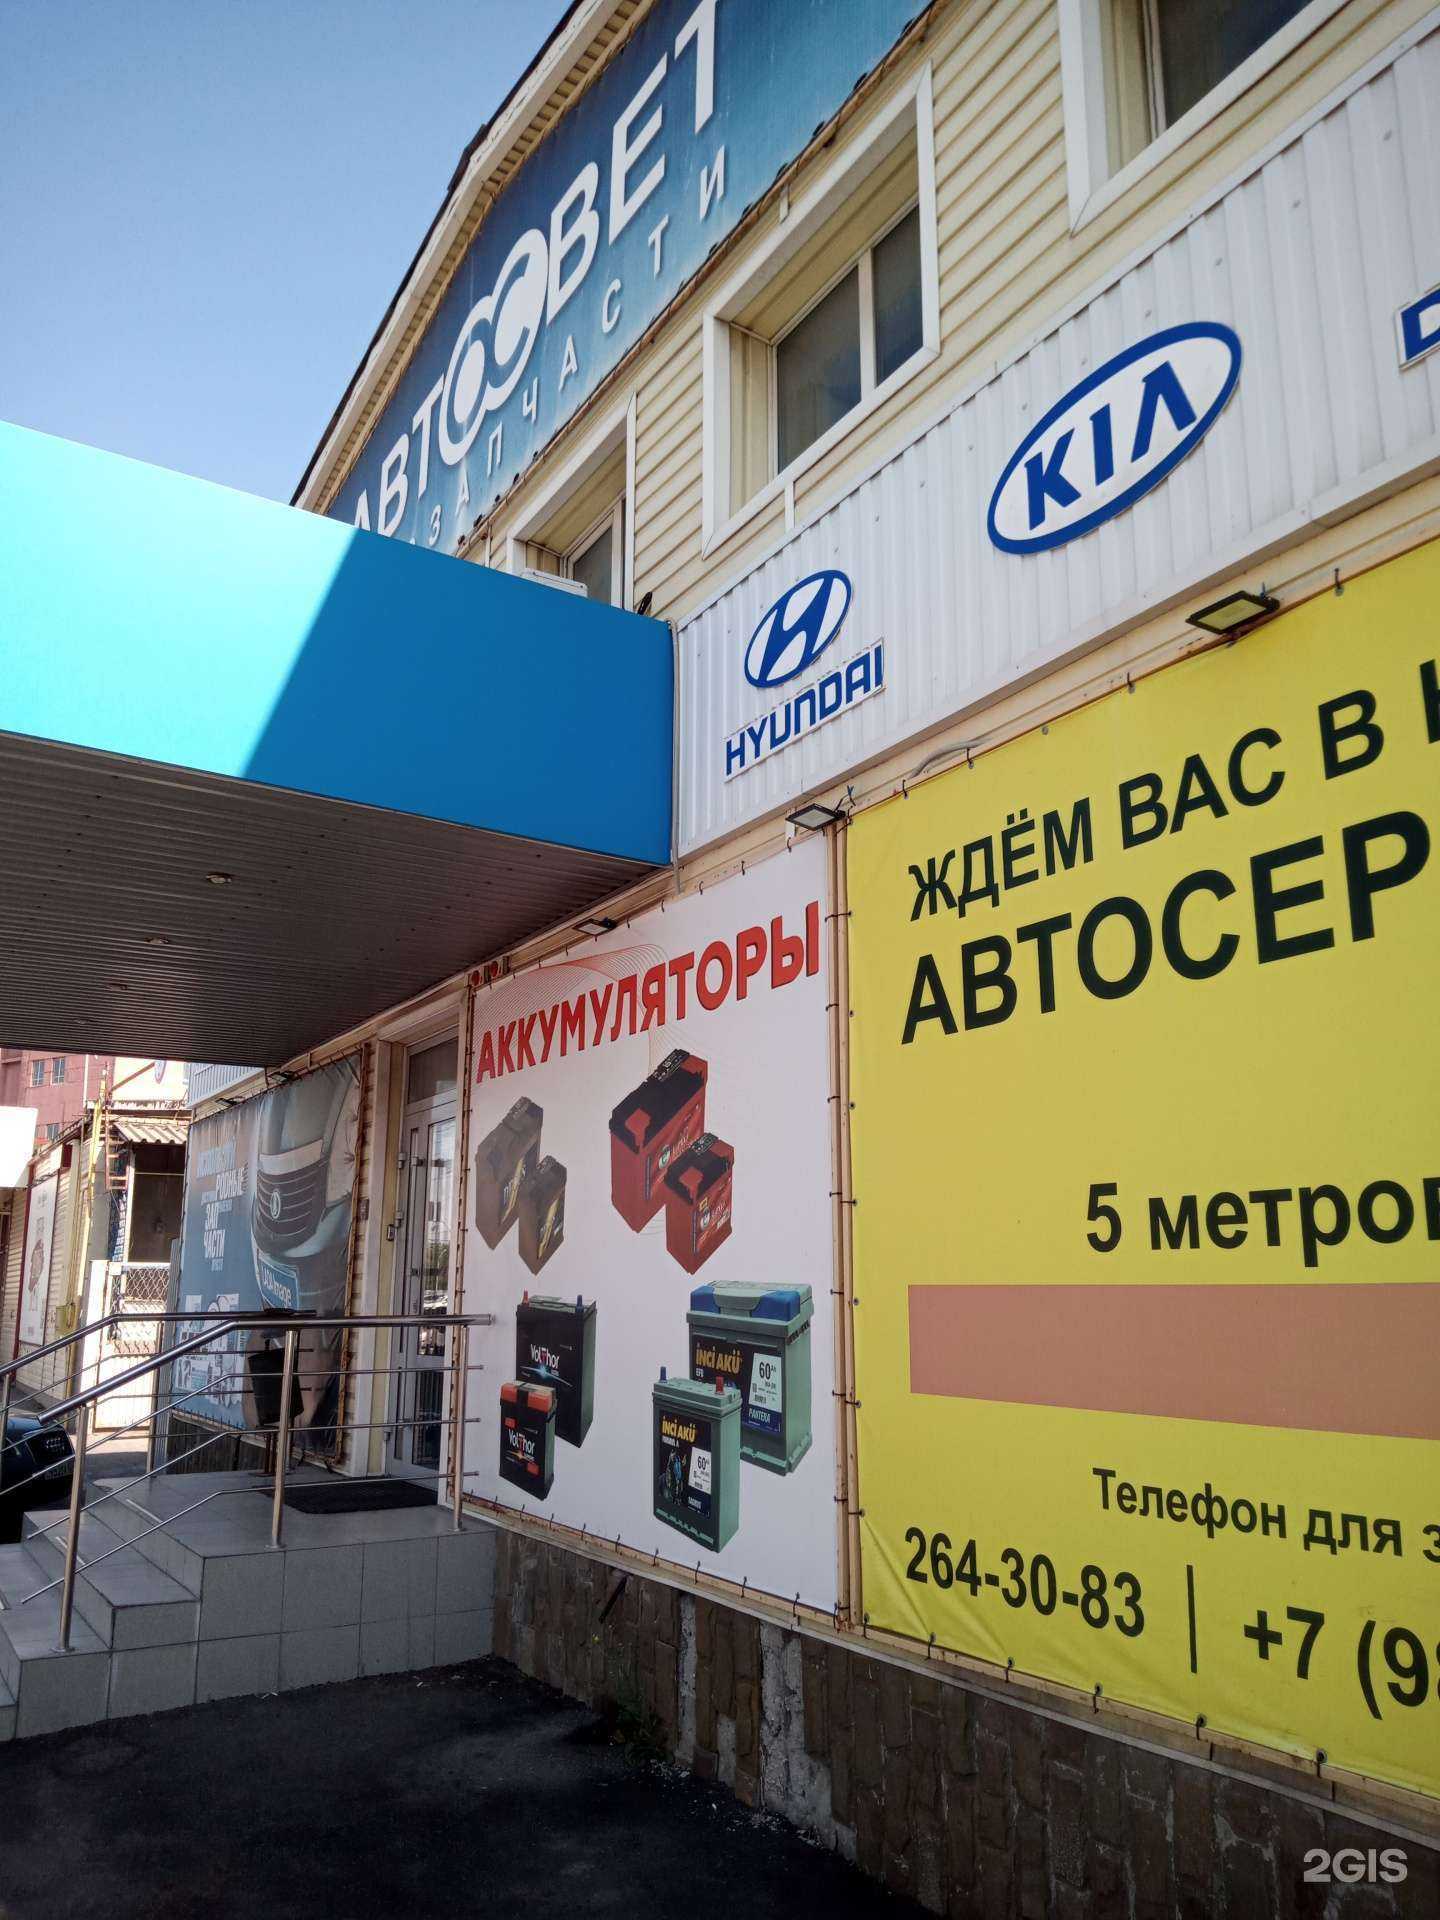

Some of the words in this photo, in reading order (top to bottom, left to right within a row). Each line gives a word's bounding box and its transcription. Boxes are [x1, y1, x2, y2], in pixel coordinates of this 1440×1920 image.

[1024, 360, 1197, 531] KIA
[725, 644, 884, 776] HYUNDAI
[908, 796, 1094, 922] ЖДЁМ
[1119, 727, 1286, 850] ВАС
[1318, 690, 1385, 781] В
[475, 900, 819, 1084] АККУМУЛЯТОРЫ
[901, 811, 1432, 1045] АВТОСЕР
[1086, 1182, 1122, 1253] 5
[759, 1361, 771, 1380] 60
[697, 1456, 706, 1471] 60
[1092, 1467, 1287, 1538] Телефон
[1303, 1508, 1403, 1557] для
[904, 1526, 1146, 1637] 264-30-83
[1244, 1606, 1325, 1680] +7
[1357, 1619, 1440, 1720] (9
